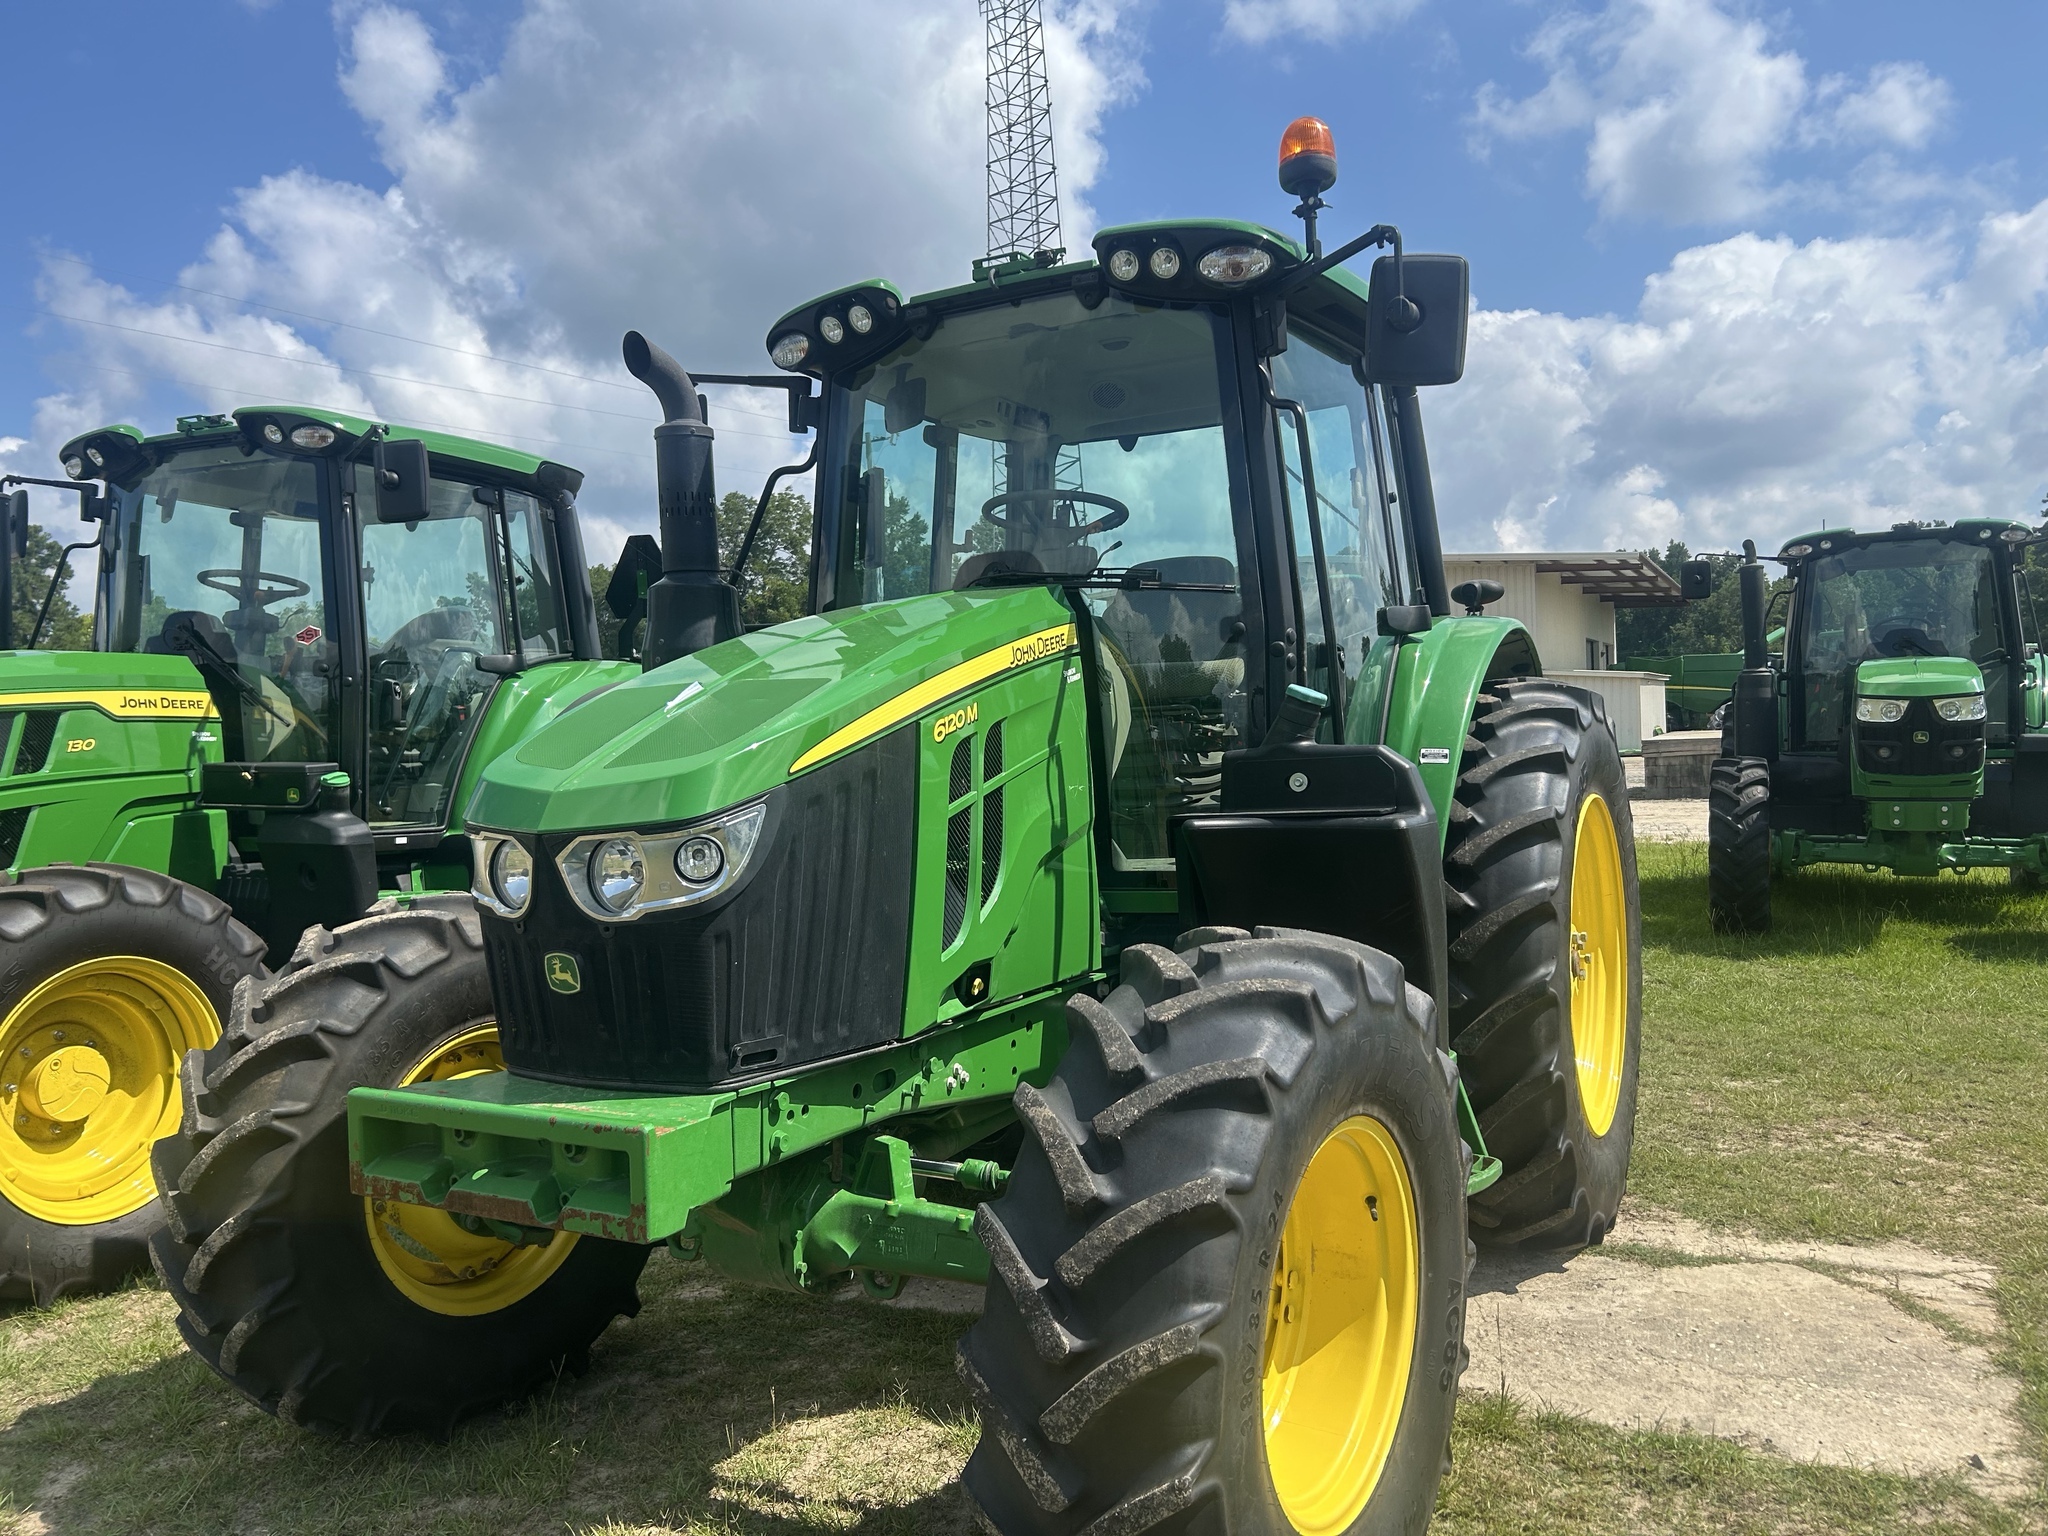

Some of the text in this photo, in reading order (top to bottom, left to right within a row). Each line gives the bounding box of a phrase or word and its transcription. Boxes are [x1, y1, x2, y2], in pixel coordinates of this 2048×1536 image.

[1010, 633, 1067, 665] JOHN DEERE
[120, 696, 204, 709] JOHN DEERE
[66, 738, 96, 753] 130
[1438, 1277, 1463, 1396] AC85
